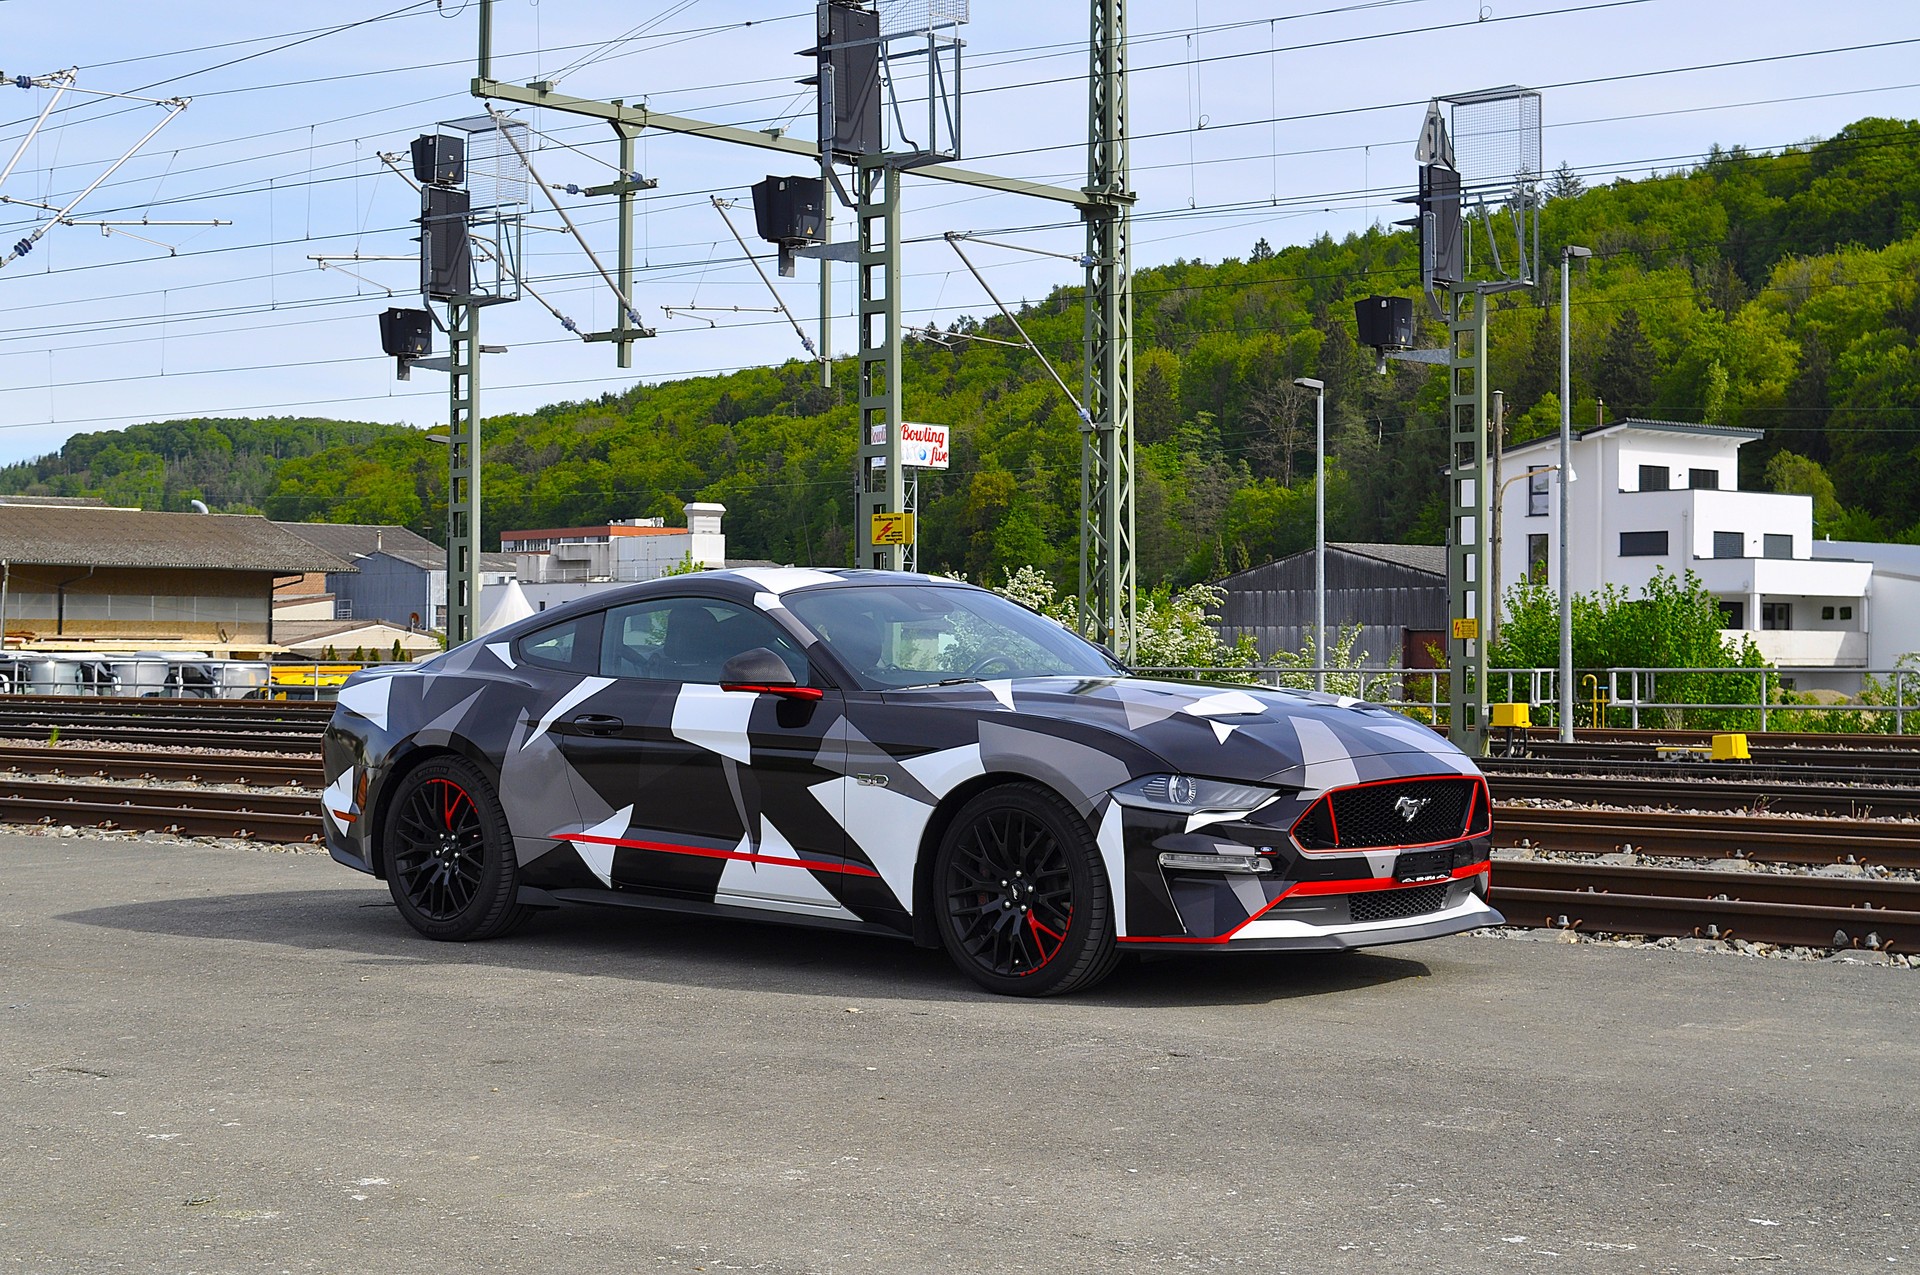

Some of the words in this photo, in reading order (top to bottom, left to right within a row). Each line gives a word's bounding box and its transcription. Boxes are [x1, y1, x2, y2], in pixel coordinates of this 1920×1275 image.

[901, 424, 944, 448] Bowling
[929, 446, 948, 465] five
[857, 773, 889, 787] 5.0
